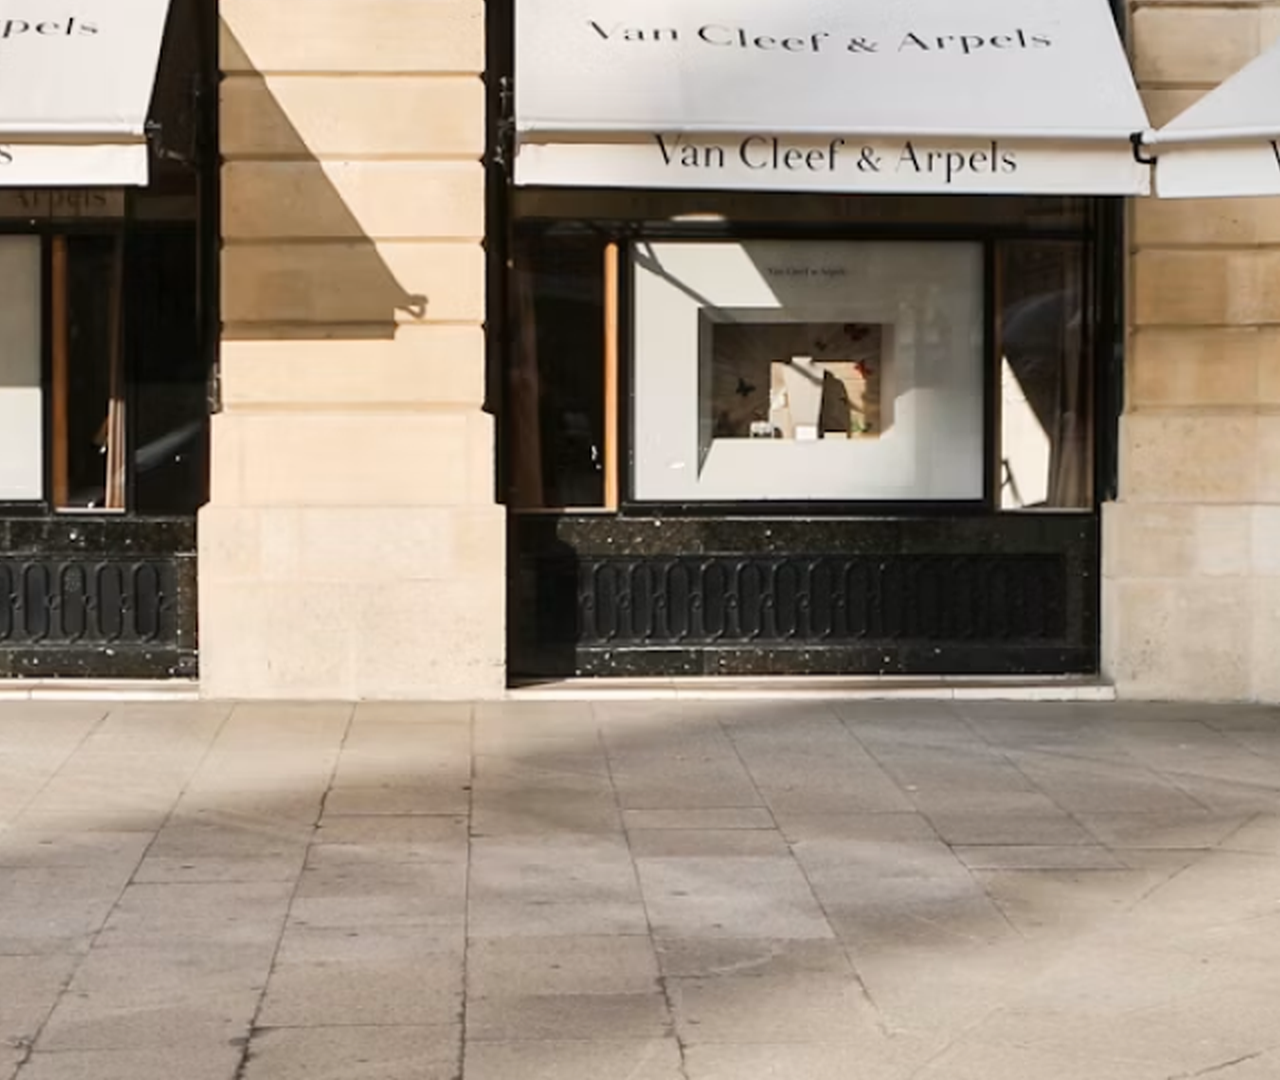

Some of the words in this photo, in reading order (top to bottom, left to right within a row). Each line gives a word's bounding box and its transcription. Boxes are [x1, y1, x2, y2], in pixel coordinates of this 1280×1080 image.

[590, 20, 679, 42] Van
[698, 23, 829, 53] Cleef
[848, 35, 880, 53] &
[897, 29, 1052, 54] Arpels
[656, 134, 724, 169] Van
[740, 135, 845, 172] Cleef
[856, 143, 882, 173] &
[894, 140, 1018, 182] Arpels
